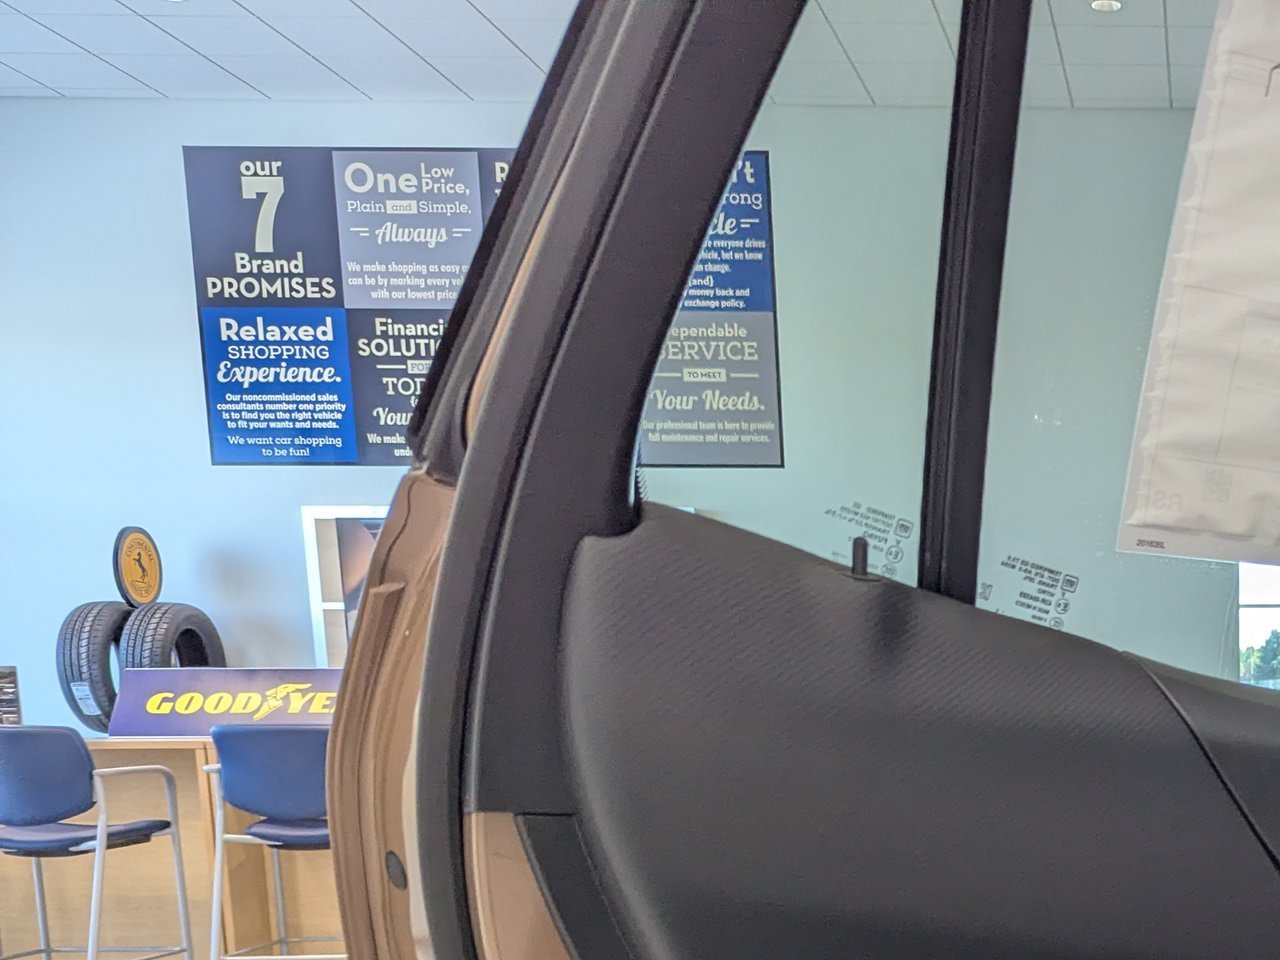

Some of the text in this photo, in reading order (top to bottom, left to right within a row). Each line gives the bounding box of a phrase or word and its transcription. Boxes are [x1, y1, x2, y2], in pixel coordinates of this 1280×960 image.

[240, 160, 282, 176] our
[344, 162, 454, 193] One Low
[421, 178, 470, 196] Price,
[347, 201, 385, 213] Plain
[392, 202, 412, 212] and
[723, 193, 762, 209] rong
[241, 176, 284, 252] 7
[375, 222, 448, 248] Always
[234, 252, 304, 274] Brand
[347, 262, 360, 271] We
[363, 262, 386, 271] make
[388, 262, 427, 274] shopping
[429, 264, 439, 272] as
[441, 264, 459, 274] easy
[206, 277, 336, 299] PROMISES
[349, 277, 363, 285] can
[365, 275, 376, 285] be
[378, 275, 388, 289] by
[390, 276, 425, 288] marking
[427, 277, 449, 288] every
[371, 290, 389, 298] with
[407, 289, 434, 299] lowest
[219, 317, 333, 342] Relaxed
[374, 318, 447, 336] Financi
[672, 323, 747, 339] ependable
[228, 346, 329, 360] SHOPPING
[217, 361, 342, 388] Experience.
[226, 393, 240, 401] Our
[243, 393, 316, 401] noncommissioned
[650, 390, 765, 411] Your Needs.
[316, 403, 346, 411] priority
[292, 412, 311, 420] right
[227, 436, 245, 444] We
[294, 436, 342, 447] shopping
[367, 433, 381, 443] We
[262, 448, 310, 456] to be fun!
[146, 691, 337, 715] GOODYE
